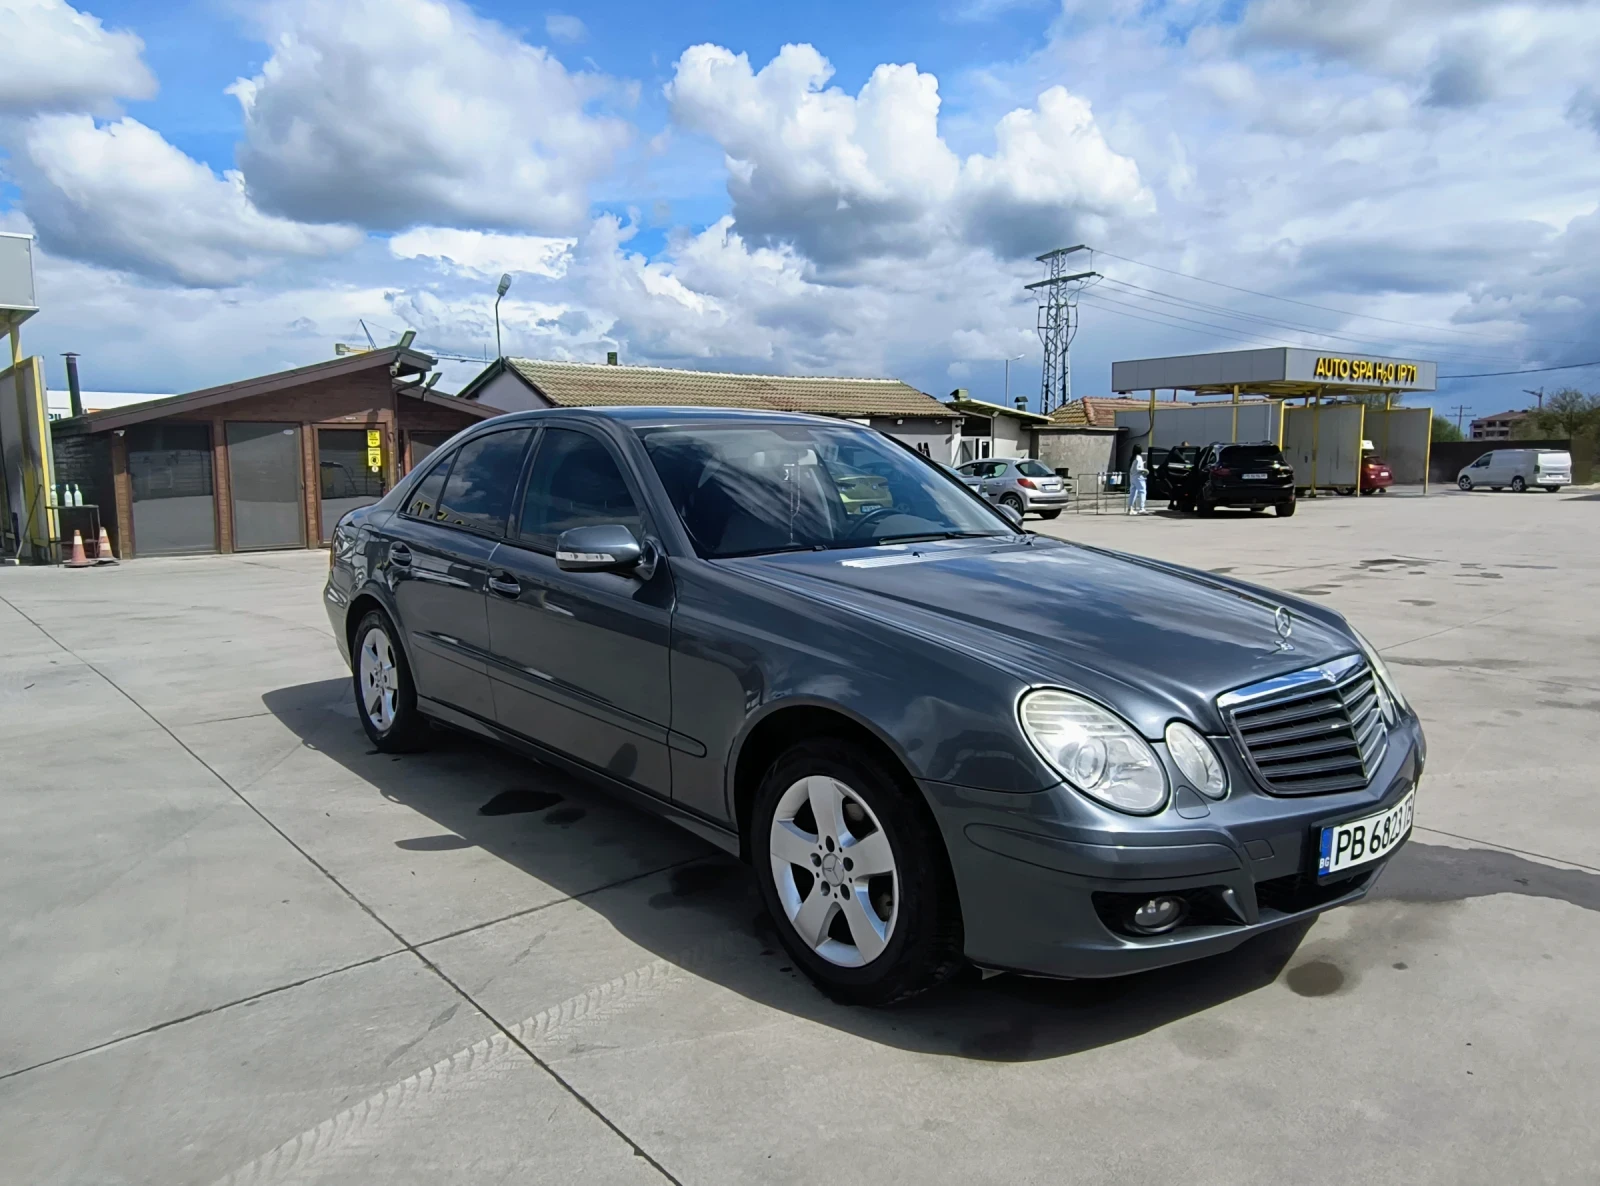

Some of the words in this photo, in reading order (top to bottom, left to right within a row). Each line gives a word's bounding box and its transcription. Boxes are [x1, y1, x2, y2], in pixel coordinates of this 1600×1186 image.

[1315, 357, 1350, 378] AUTO
[1351, 360, 1373, 380] SPA
[1334, 825, 1366, 866] PB
[1369, 806, 1403, 854] 6823
[1319, 857, 1330, 869] BG
